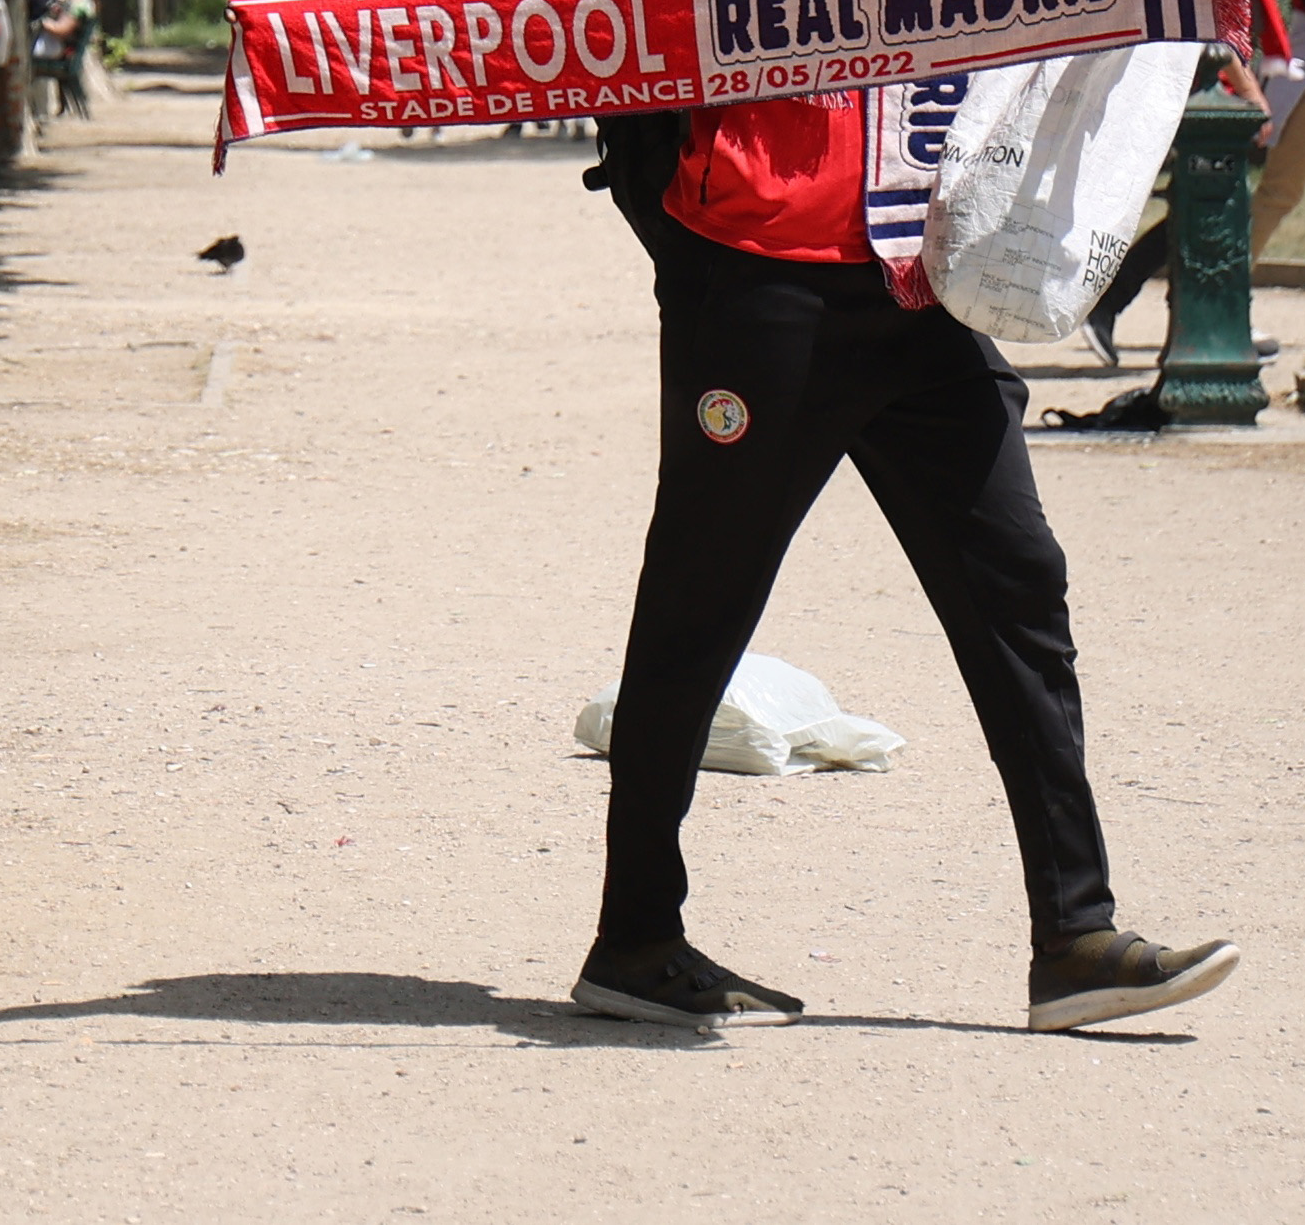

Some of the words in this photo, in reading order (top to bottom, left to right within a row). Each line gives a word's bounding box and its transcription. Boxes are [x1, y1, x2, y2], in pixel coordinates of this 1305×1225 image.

[707, 50, 916, 98] 28/05/2022
[360, 95, 475, 121] STADE
[487, 91, 534, 116] DE
[546, 77, 696, 112] FRANCE
[1090, 229, 1129, 260] NIKE
